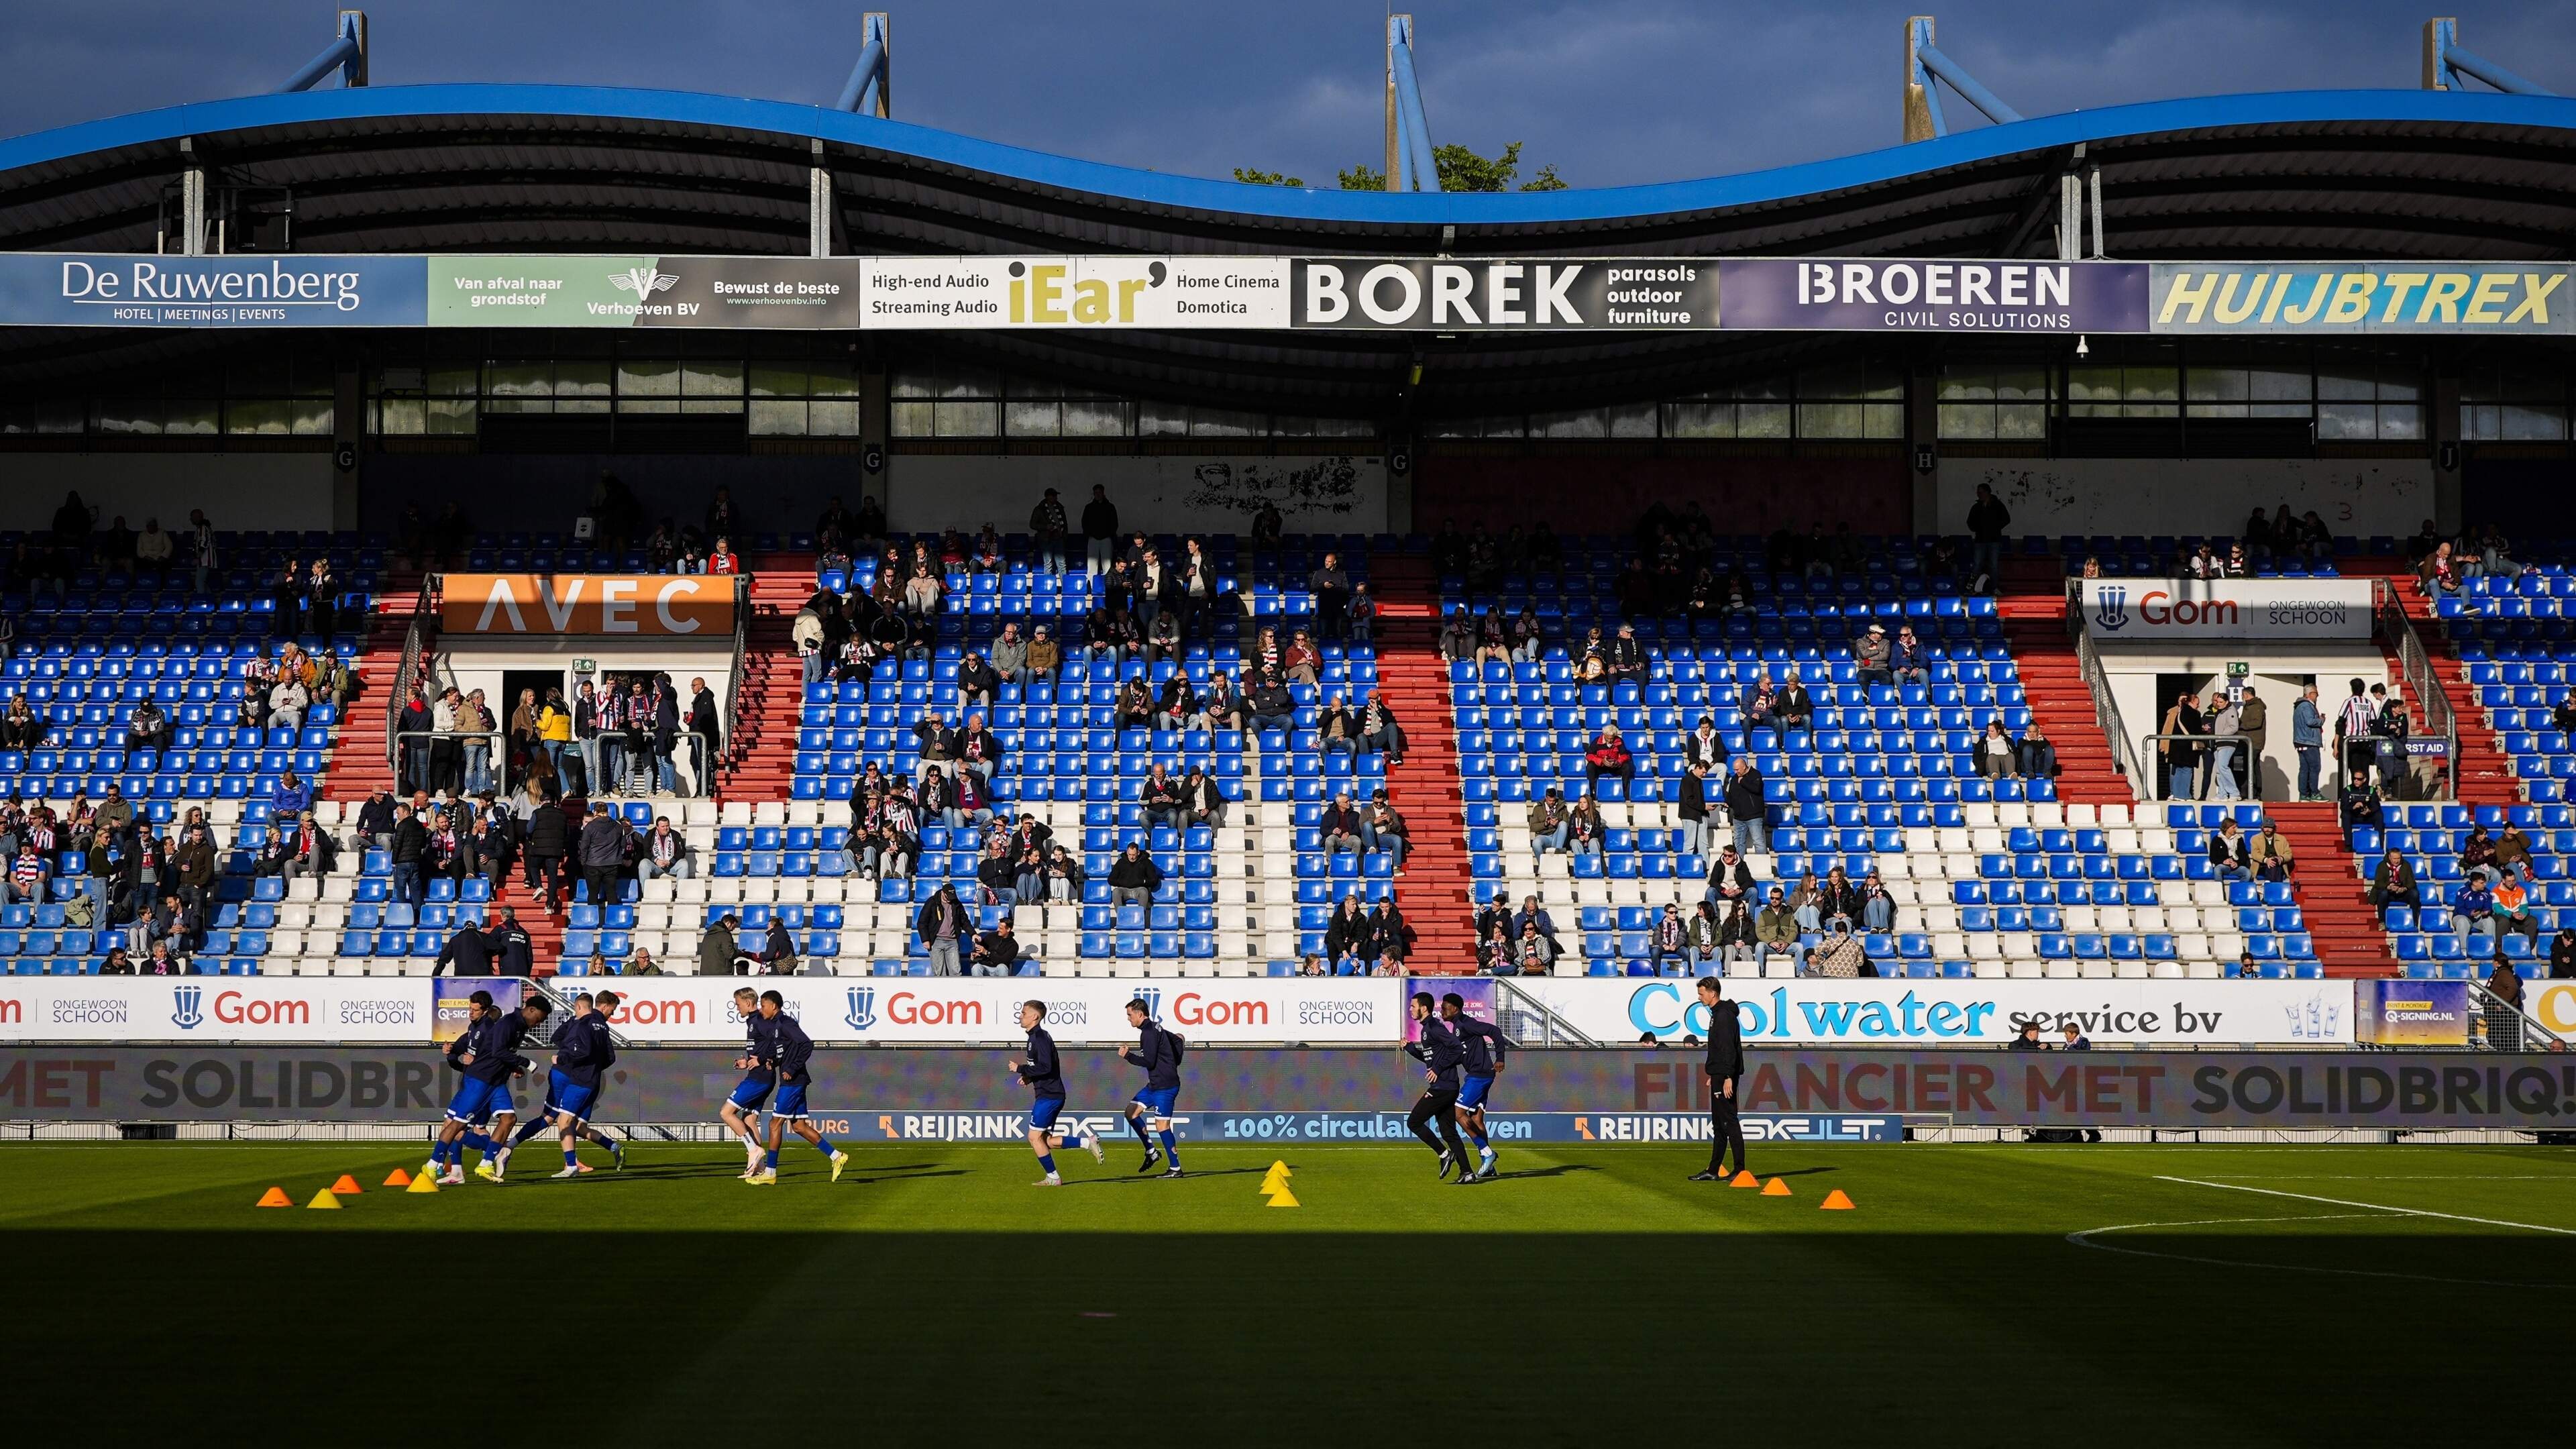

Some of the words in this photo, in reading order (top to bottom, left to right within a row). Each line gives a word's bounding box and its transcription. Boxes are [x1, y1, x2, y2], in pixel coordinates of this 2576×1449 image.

[873, 275, 941, 291] High-end
[947, 275, 989, 288] Audio
[1177, 275, 1220, 288] Home
[1224, 275, 1280, 288] Cinema
[1608, 265, 1696, 285] parasols
[62, 261, 119, 298] De
[133, 260, 360, 311] Ruwenberg
[455, 278, 485, 290] Van
[488, 277, 525, 290] afval
[529, 278, 563, 290] naar
[714, 282, 770, 294] Bewust
[774, 282, 795, 294] de
[798, 282, 840, 295] beste
[1799, 263, 2070, 306] BROEREN
[470, 293, 547, 307] grondstof
[727, 297, 827, 307] www.verhoevenbv.info
[1307, 264, 1585, 325] BOREK
[1607, 288, 1682, 304] outdoor
[2157, 273, 2568, 325] HUIJBTREX
[114, 308, 154, 320] HOTEL
[165, 309, 228, 321] MEETINGS
[240, 309, 286, 320] EVENTS
[587, 303, 673, 316] Verhoeven
[678, 303, 700, 315] BV
[872, 300, 951, 317] Streaming
[955, 300, 998, 313] Audio
[1177, 301, 1248, 314] Domotica
[1607, 308, 1692, 324] furniture
[1884, 311, 1939, 327] CIVIL
[1948, 313, 2071, 329] SOLUTIONS
[339, 451, 353, 466] G
[867, 452, 880, 468] G
[1393, 454, 1407, 470] G
[1917, 453, 1933, 468] H
[475, 579, 702, 633] AVEC
[2140, 591, 2238, 625] Gom
[2269, 601, 2346, 611] ONGEWOON
[2269, 611, 2346, 625] SCHOON
[2228, 686, 2245, 702] H
[2406, 743, 2424, 752] RST
[2426, 743, 2444, 752] AID
[53, 1000, 127, 1010] ONGEWOON
[214, 991, 309, 1024] Gom
[341, 1000, 415, 1010] ONGEWOON
[888, 991, 982, 1024] Gom
[1173, 992, 1268, 1025] Gom
[1299, 1001, 1373, 1010] ONGEWOON
[53, 1009, 127, 1023] SCHOON
[341, 1010, 415, 1024] SCHOON
[1299, 1011, 1373, 1025] SCHOON
[2008, 1004, 2161, 1034] service
[2174, 1002, 2222, 1034] bv
[2385, 1010, 2455, 1023] Q-SIGNING.NL
[140, 1059, 529, 1109] SOLIDBRI!
[1633, 1062, 1998, 1112] FIANCIER
[2025, 1064, 2165, 1114] MET
[2190, 1065, 2576, 1117] SOLIDBRIQ!
[904, 1116, 1024, 1142] REIJRINK
[1224, 1114, 1298, 1138] 100%
